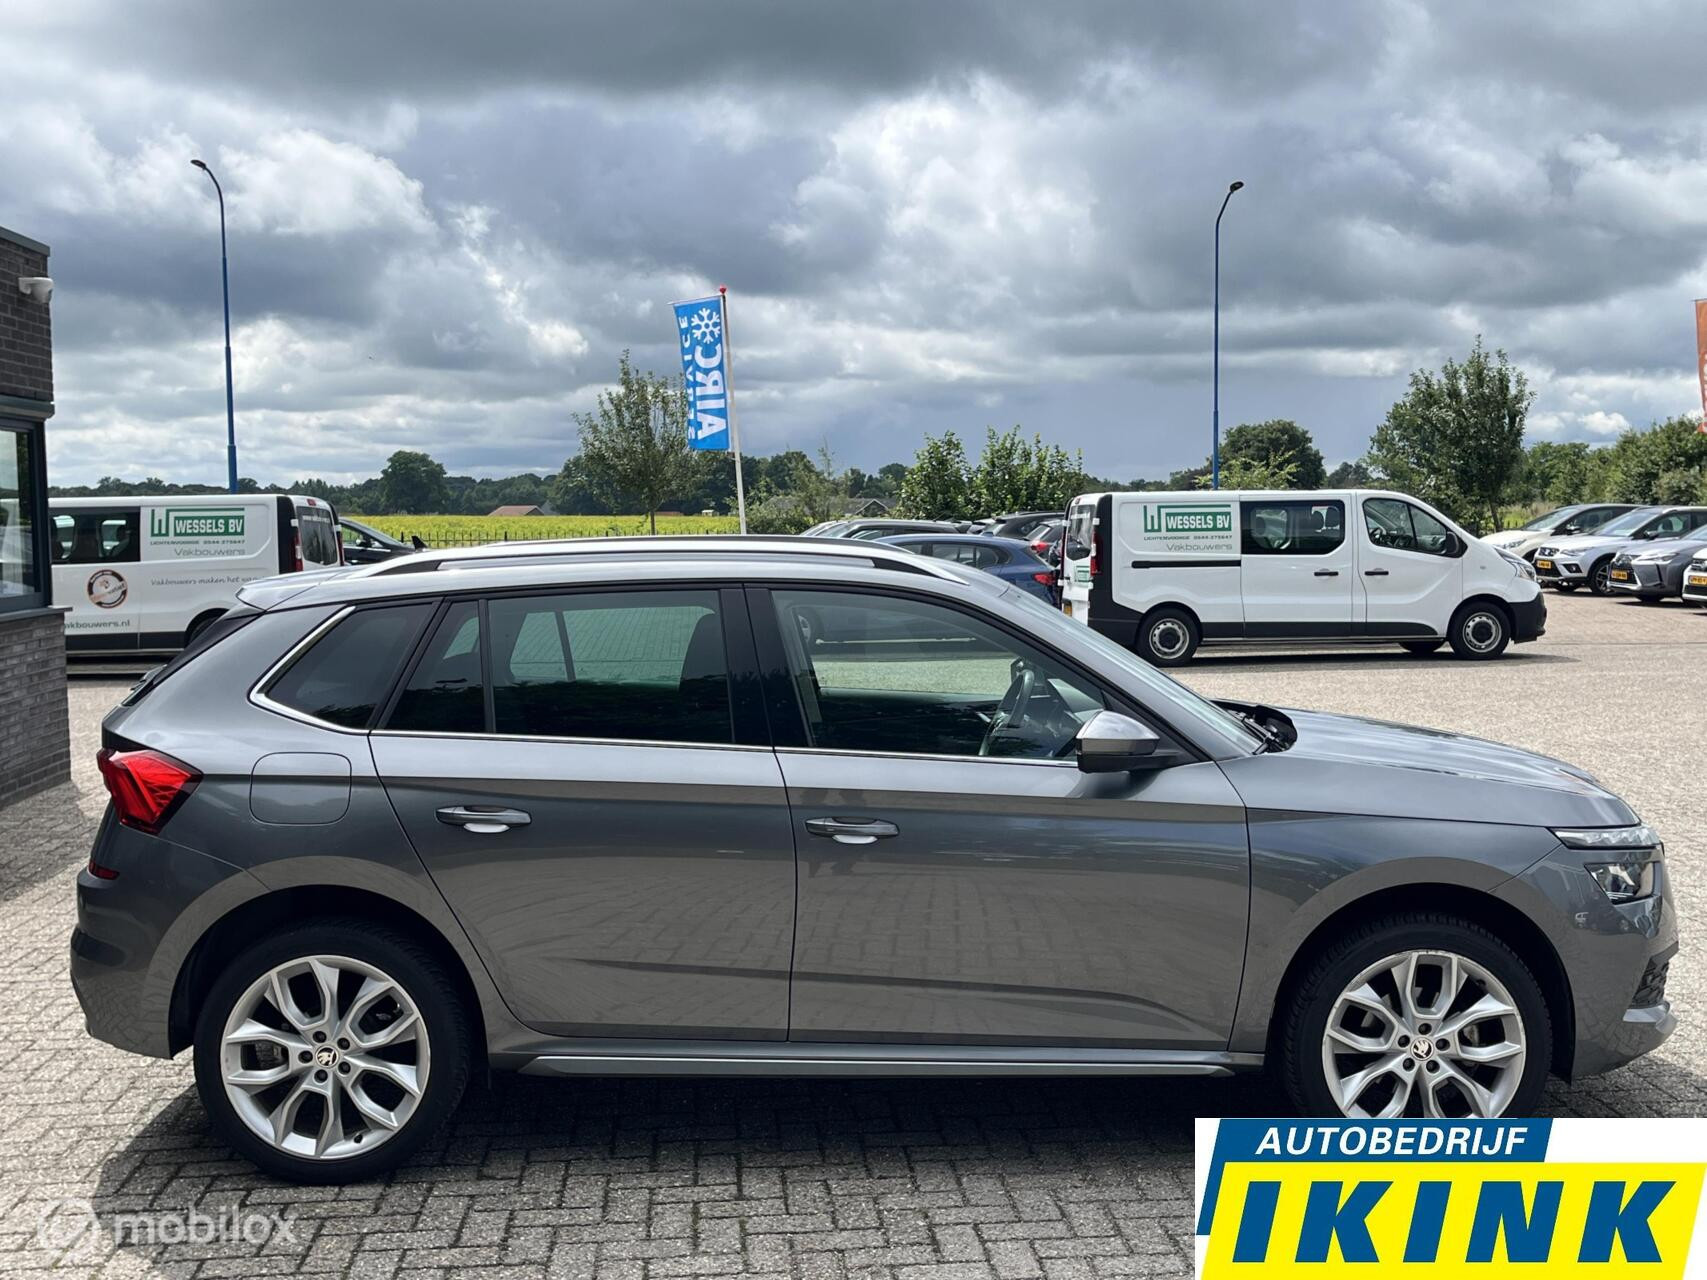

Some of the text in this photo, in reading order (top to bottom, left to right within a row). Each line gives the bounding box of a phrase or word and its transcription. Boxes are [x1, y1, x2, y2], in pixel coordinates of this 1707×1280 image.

[175, 518, 243, 534] WESSELS BV
[1166, 514, 1230, 529] WESSELS BV
[174, 547, 246, 556] Vakbouwers
[1166, 543, 1233, 552] Vakbouwers
